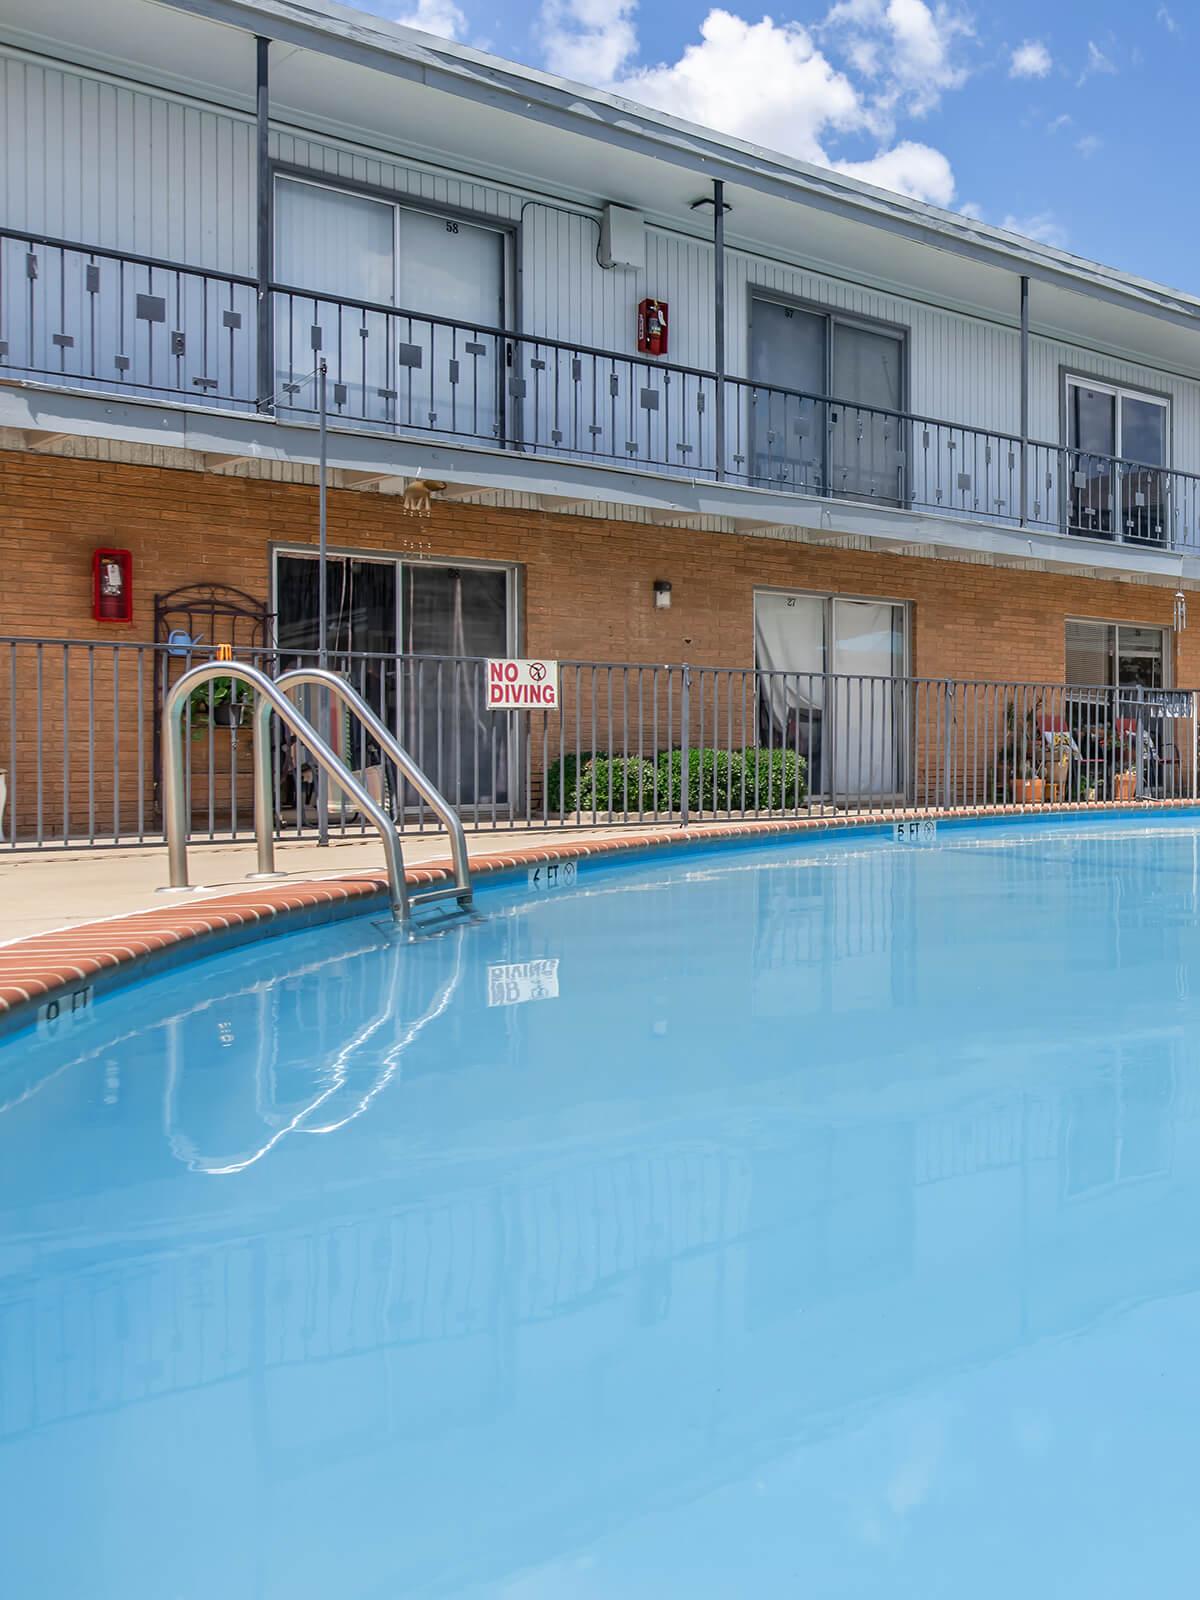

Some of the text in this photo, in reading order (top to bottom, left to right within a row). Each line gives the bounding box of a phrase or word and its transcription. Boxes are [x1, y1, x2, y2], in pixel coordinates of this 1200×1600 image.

[446, 221, 459, 234] 58
[491, 662, 519, 683] NO
[490, 684, 555, 704] DIVING
[909, 822, 920, 835] FT
[547, 864, 559, 881] FT
